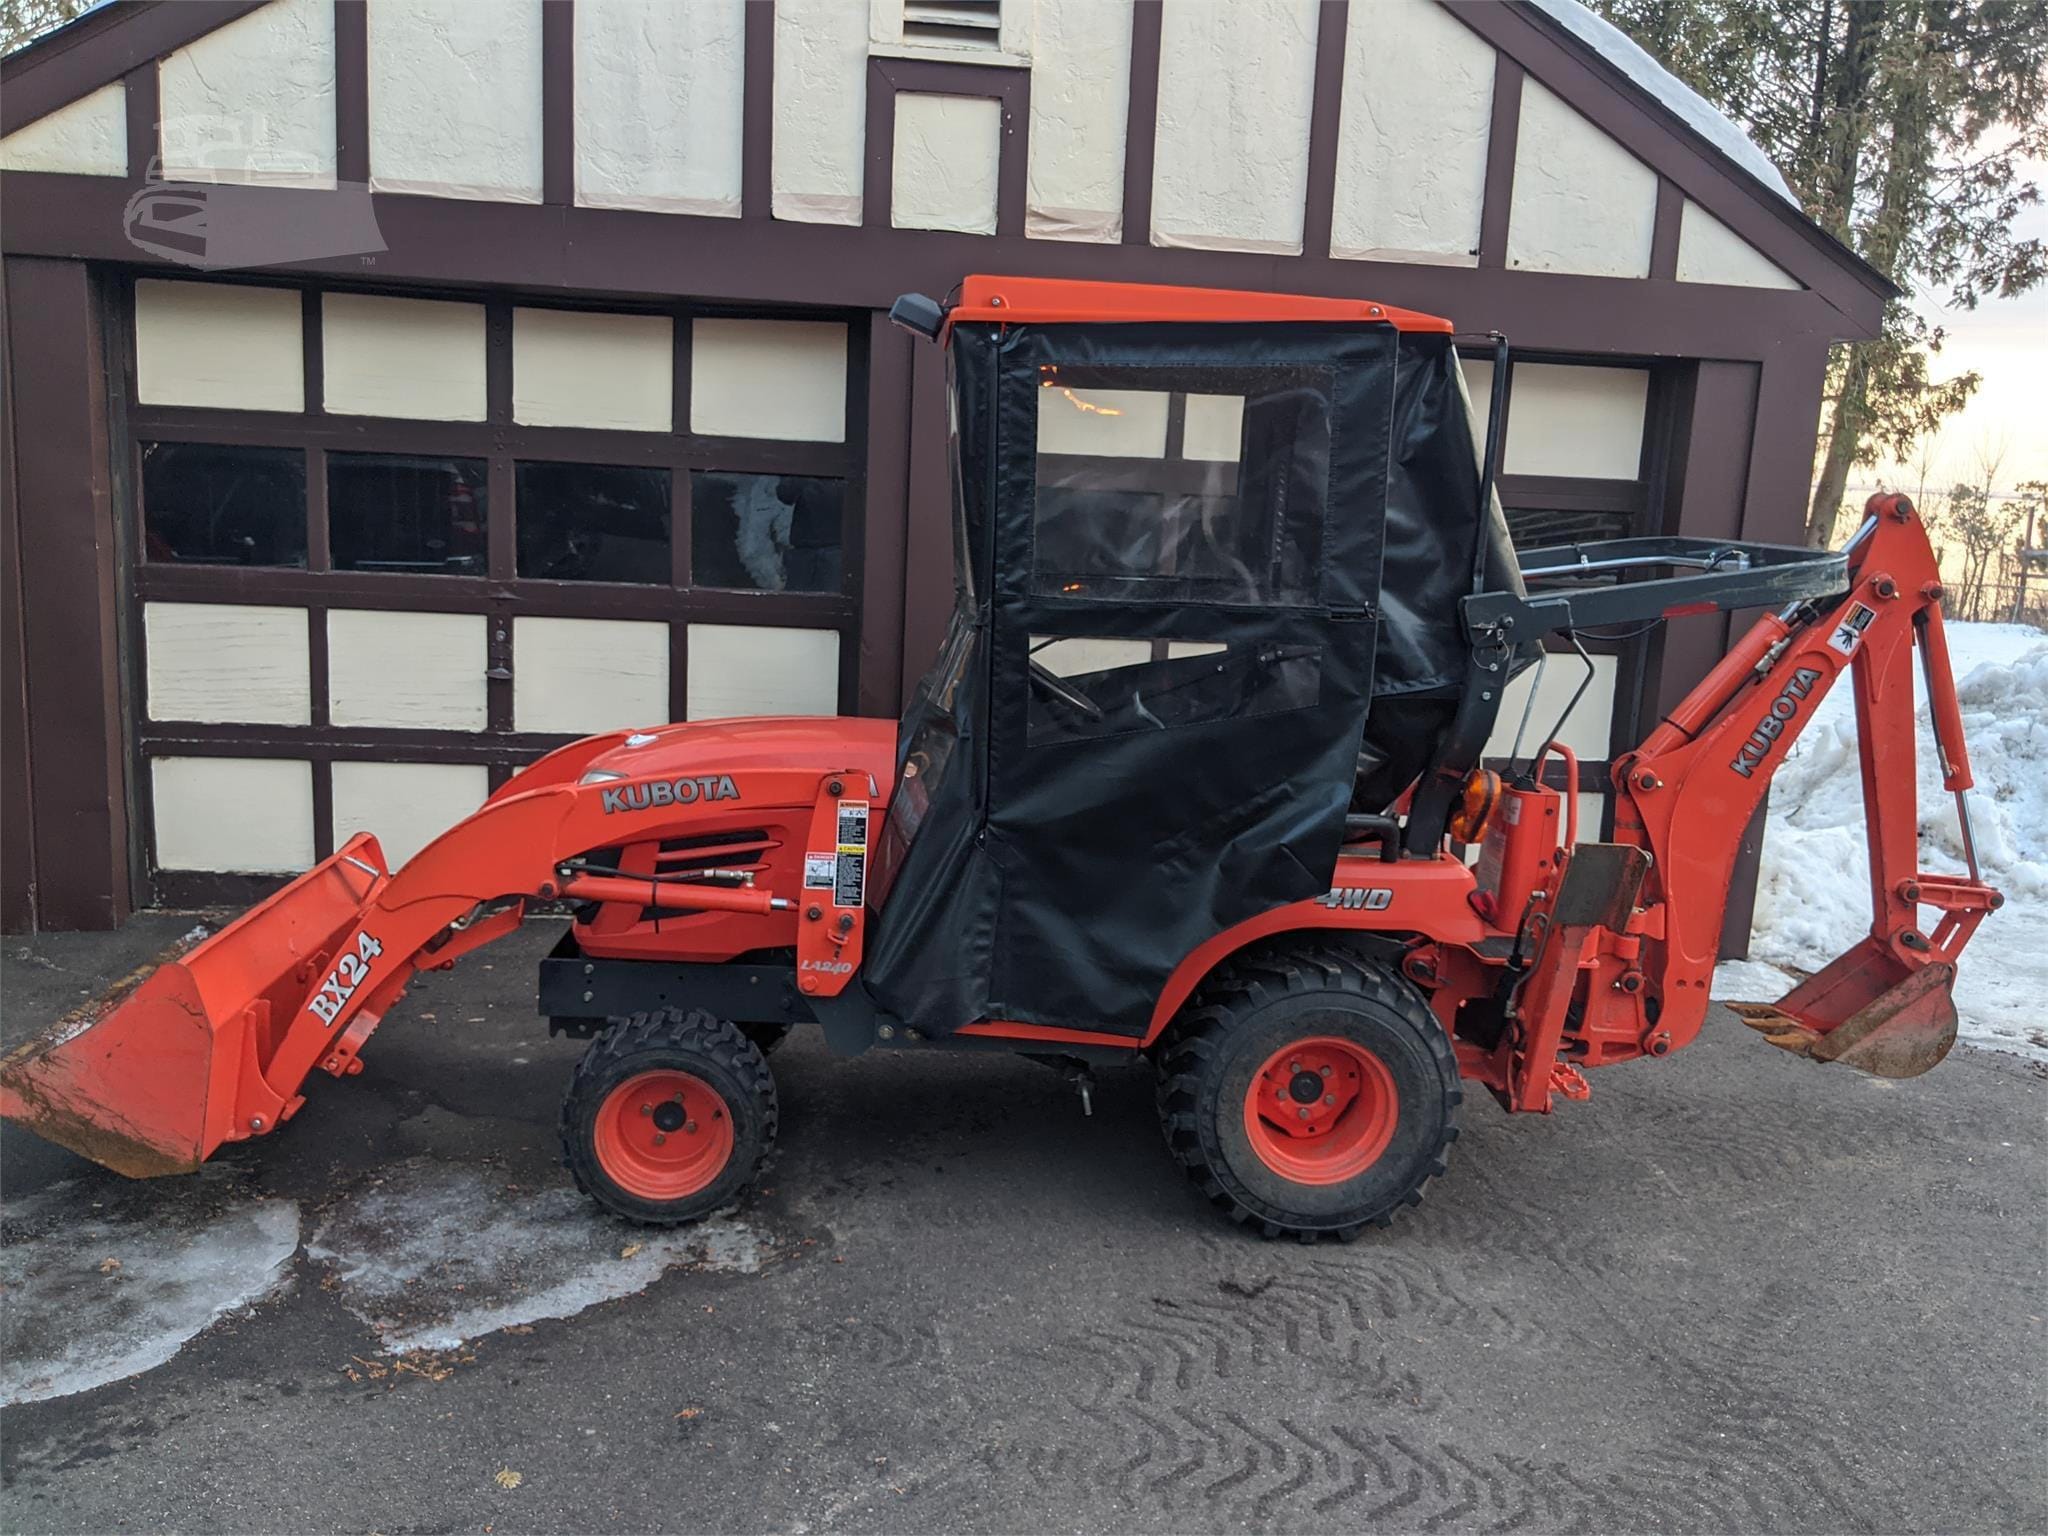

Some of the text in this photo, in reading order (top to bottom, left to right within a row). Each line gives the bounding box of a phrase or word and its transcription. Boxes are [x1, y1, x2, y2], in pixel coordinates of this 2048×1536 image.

[1729, 667, 1823, 778] KUBOTA
[601, 776, 740, 814] KUBOTA
[1314, 887, 1393, 911] 4WD
[308, 930, 384, 1028] BX24
[801, 960, 852, 974] LA240
